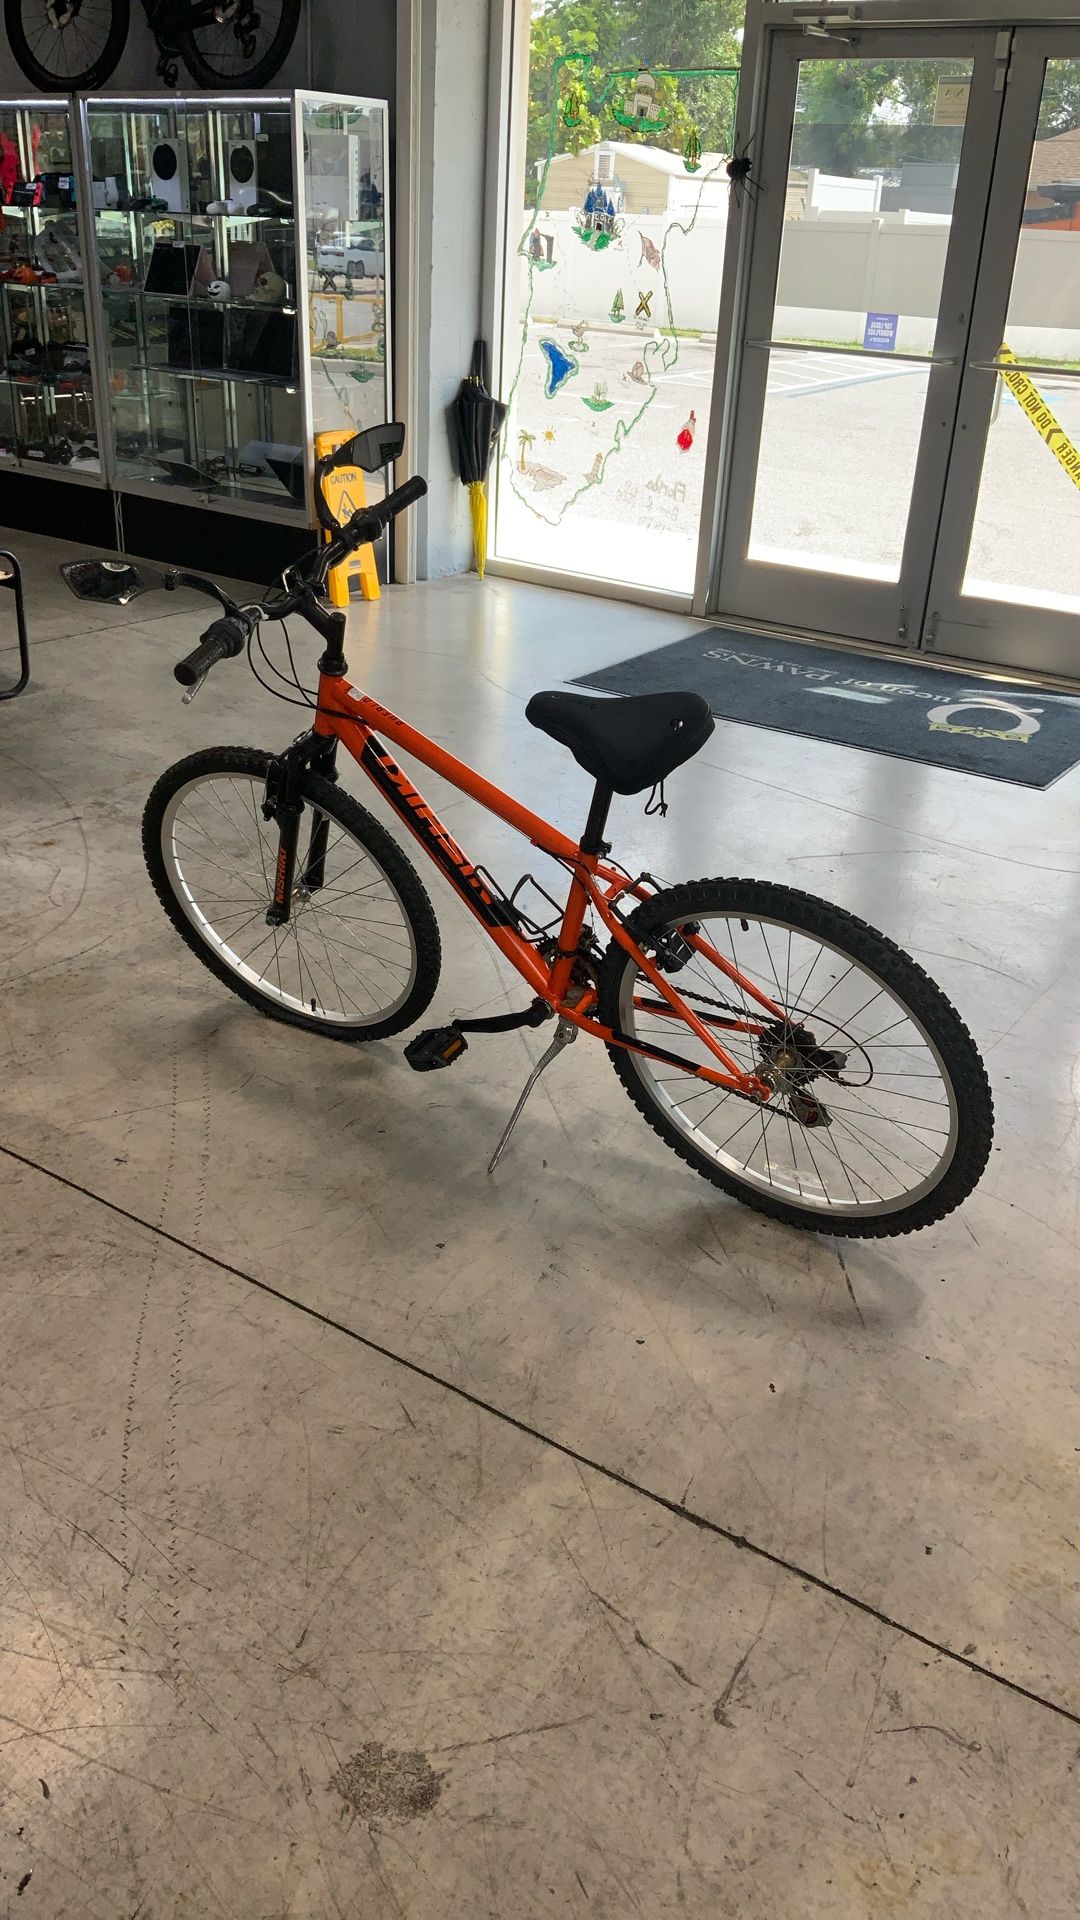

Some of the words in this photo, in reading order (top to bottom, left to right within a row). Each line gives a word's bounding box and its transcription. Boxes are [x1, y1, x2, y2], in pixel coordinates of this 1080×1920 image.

[330, 472, 357, 485] CAUTION
[701, 649, 835, 681] PAWNS
[834, 678, 873, 687] of
[879, 683, 1045, 736] Queen
[373, 756, 494, 905] NISHIKI
[275, 846, 288, 905] NISHIKI
